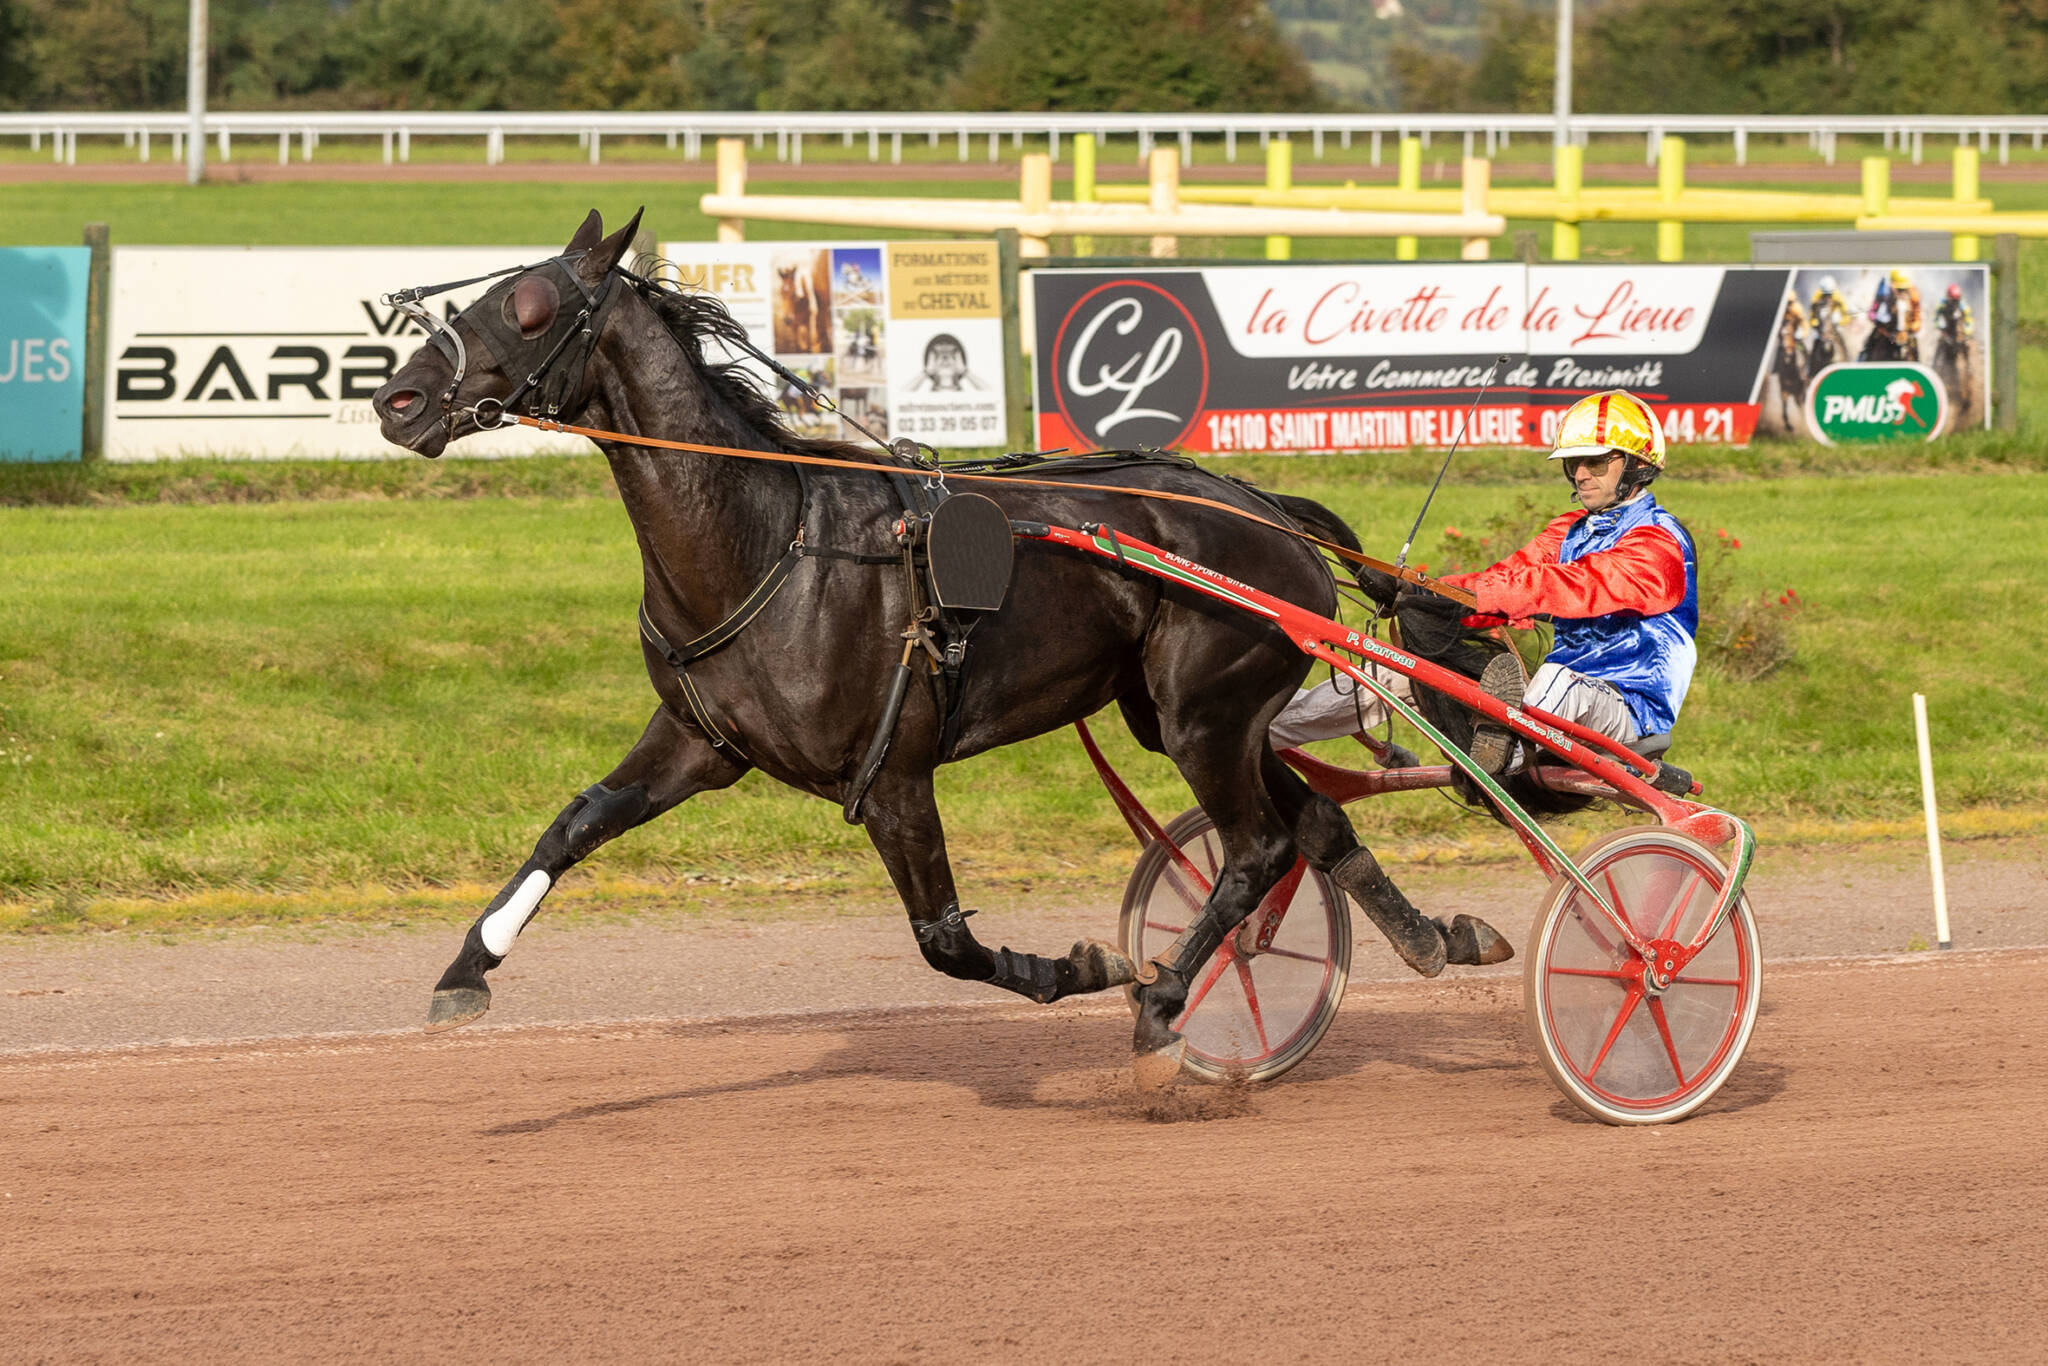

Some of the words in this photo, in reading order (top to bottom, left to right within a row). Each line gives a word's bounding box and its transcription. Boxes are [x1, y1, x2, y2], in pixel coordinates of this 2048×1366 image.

[893, 252, 988, 267] FORMATIONS
[678, 263, 756, 293] MFR
[919, 292, 991, 310] CHEVAL
[1246, 287, 1292, 335] la
[1303, 280, 1457, 345] Civette
[1461, 285, 1509, 333] de
[1520, 285, 1563, 333] la
[1570, 278, 1696, 347] Lieue
[116, 345, 404, 401] BARB
[1287, 361, 1357, 391] Votre
[1365, 358, 1495, 390] Commerce
[1503, 361, 1539, 388] de
[1545, 357, 1664, 388] Proximité
[981, 415, 999, 430] 07
[1824, 395, 1887, 424] PMU
[1207, 414, 1268, 451] 14100
[1268, 413, 1329, 450] SAINT
[1331, 411, 1409, 449] MARTIN
[1411, 411, 1436, 447] DE
[1437, 410, 1469, 446] LA
[1470, 409, 1524, 446] LIEUE
[1346, 631, 1360, 646] P.
[1362, 637, 1417, 670] Garreau
